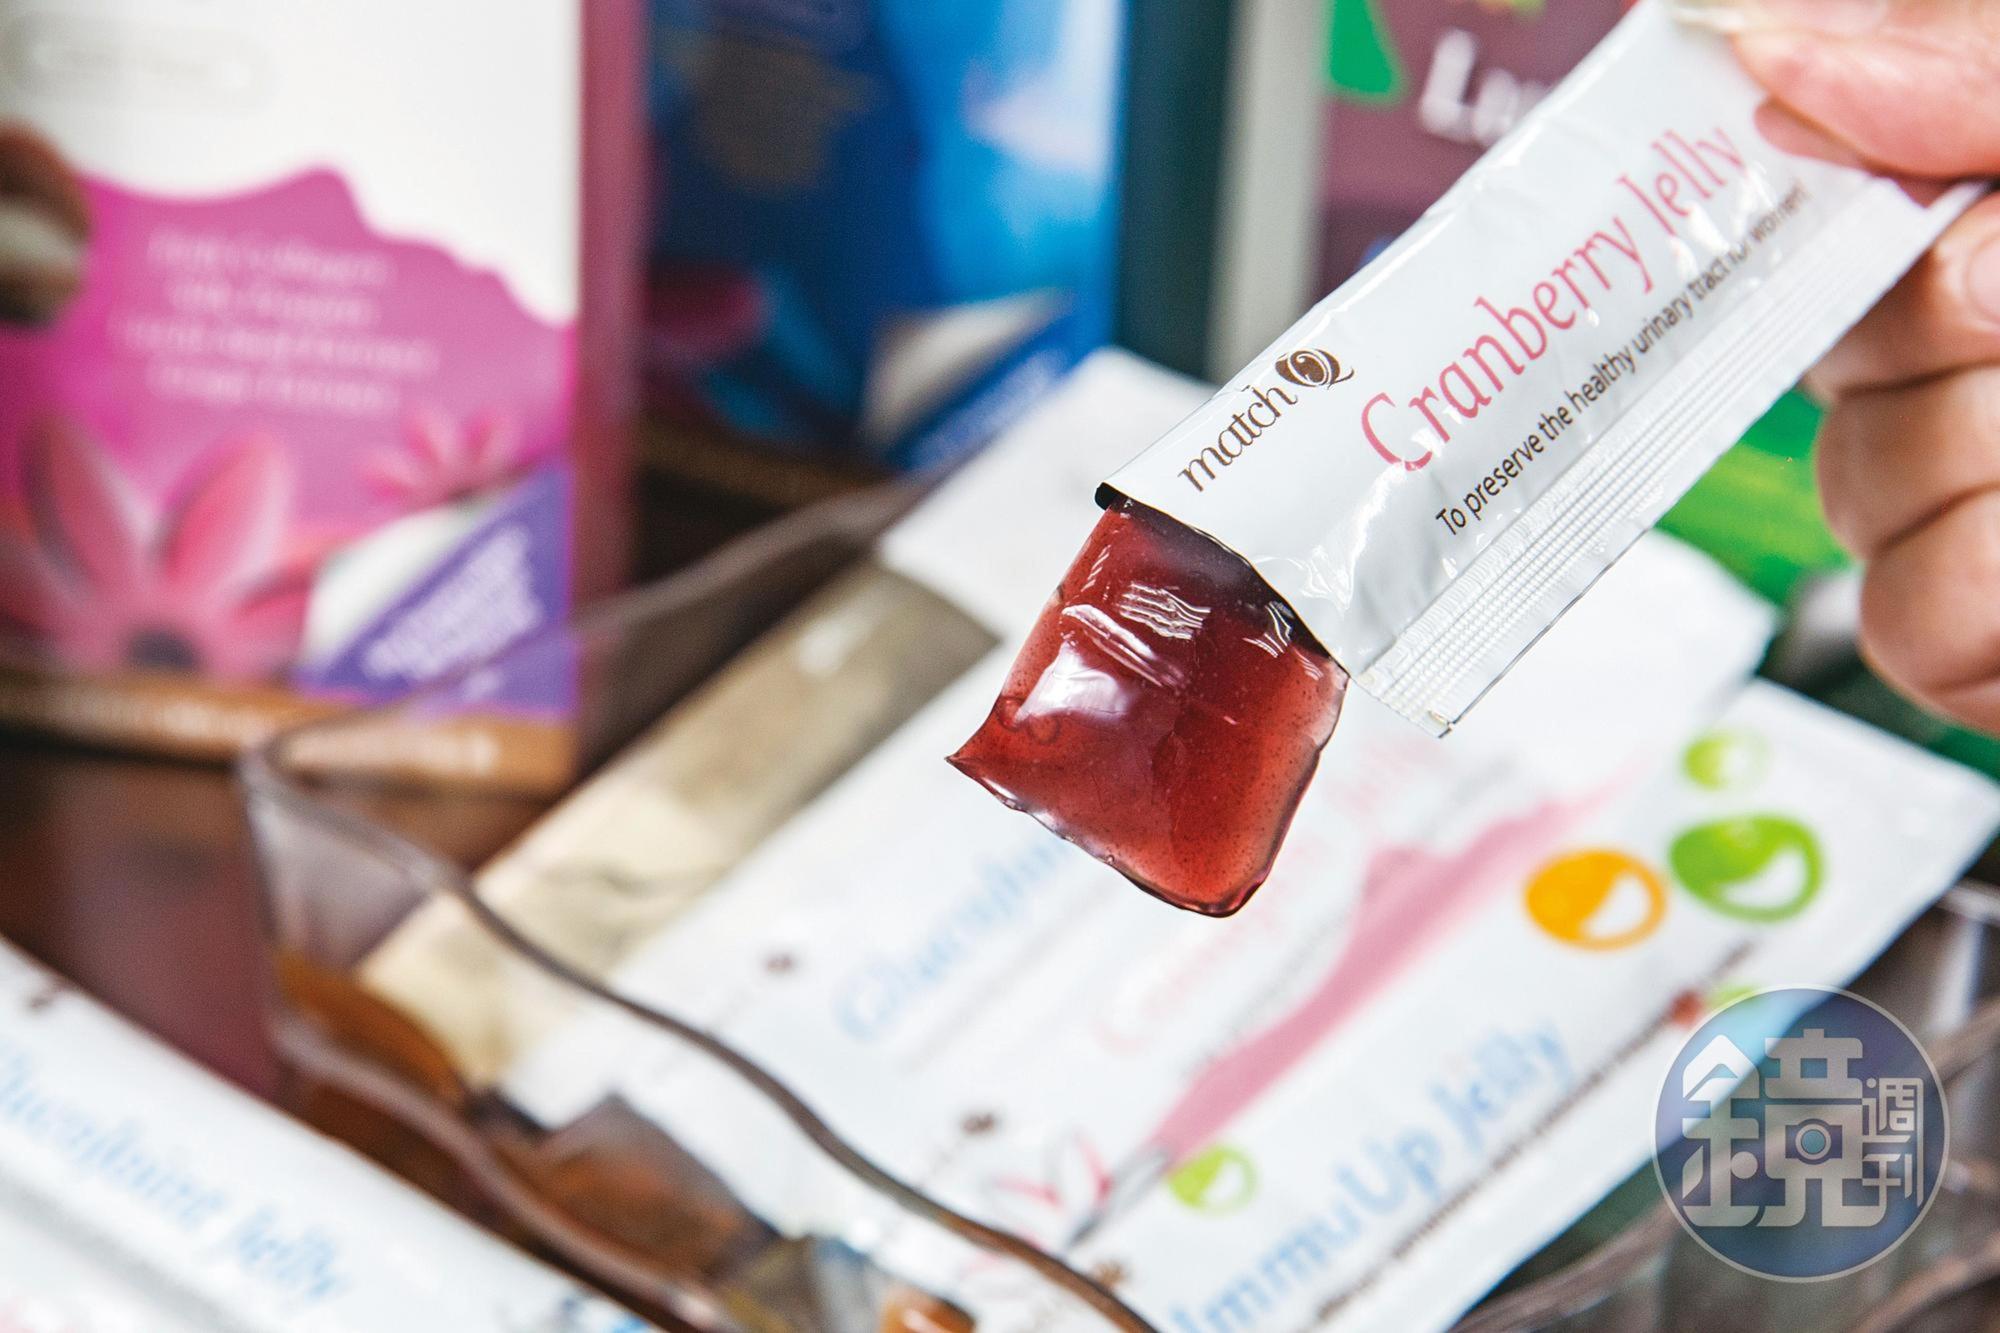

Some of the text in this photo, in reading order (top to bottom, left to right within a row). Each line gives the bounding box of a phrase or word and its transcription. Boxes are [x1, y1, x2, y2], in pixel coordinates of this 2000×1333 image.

[1361, 126, 1750, 471] Cranberry Jelly
[1435, 507, 1466, 536] To
[1463, 434, 1544, 521] preserve
[1538, 412, 1573, 441] the
[1564, 346, 1636, 413] healthy
[1632, 292, 1694, 354] urinary
[1177, 385, 1298, 492] match
